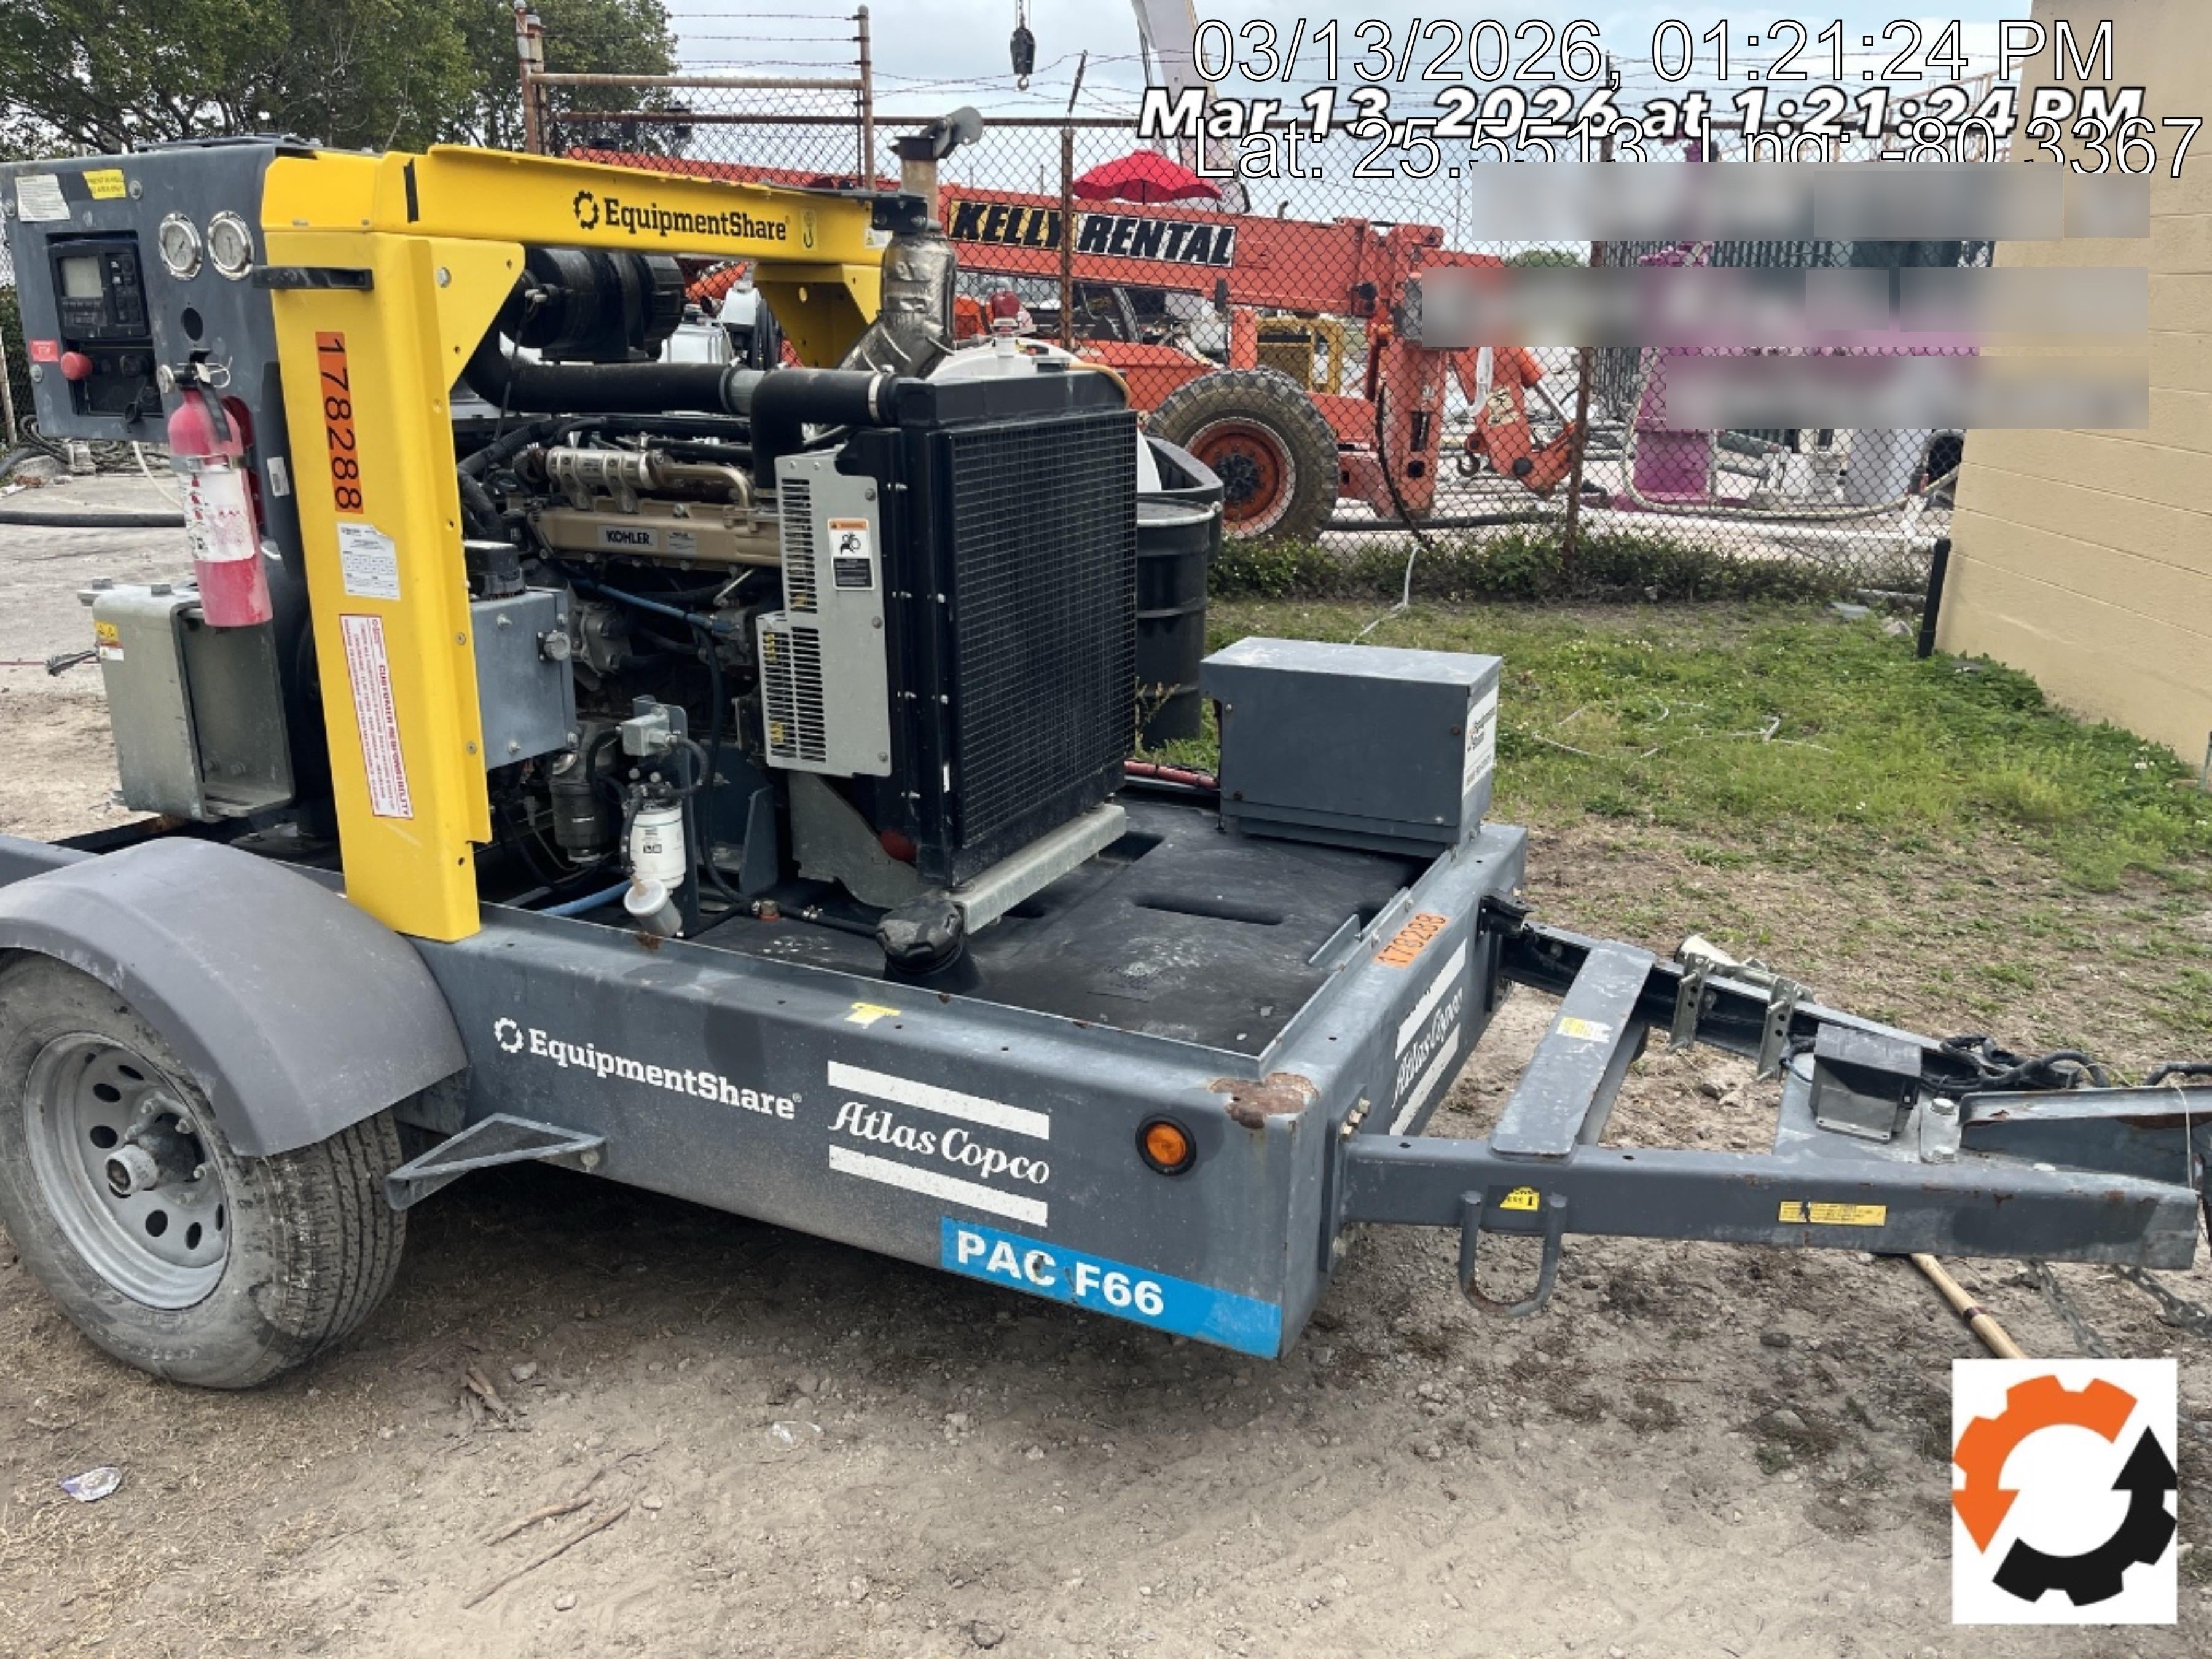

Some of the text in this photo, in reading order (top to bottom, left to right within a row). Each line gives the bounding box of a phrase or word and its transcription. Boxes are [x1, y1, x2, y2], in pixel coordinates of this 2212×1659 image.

[1078, 214, 1234, 264] RENTAL
[318, 339, 363, 510] 178288
[606, 530, 650, 545] KOHLER
[1377, 912, 1446, 967] 178288
[827, 1101, 1050, 1185] Atlas Copco
[957, 1228, 1164, 1316] PAC F66
